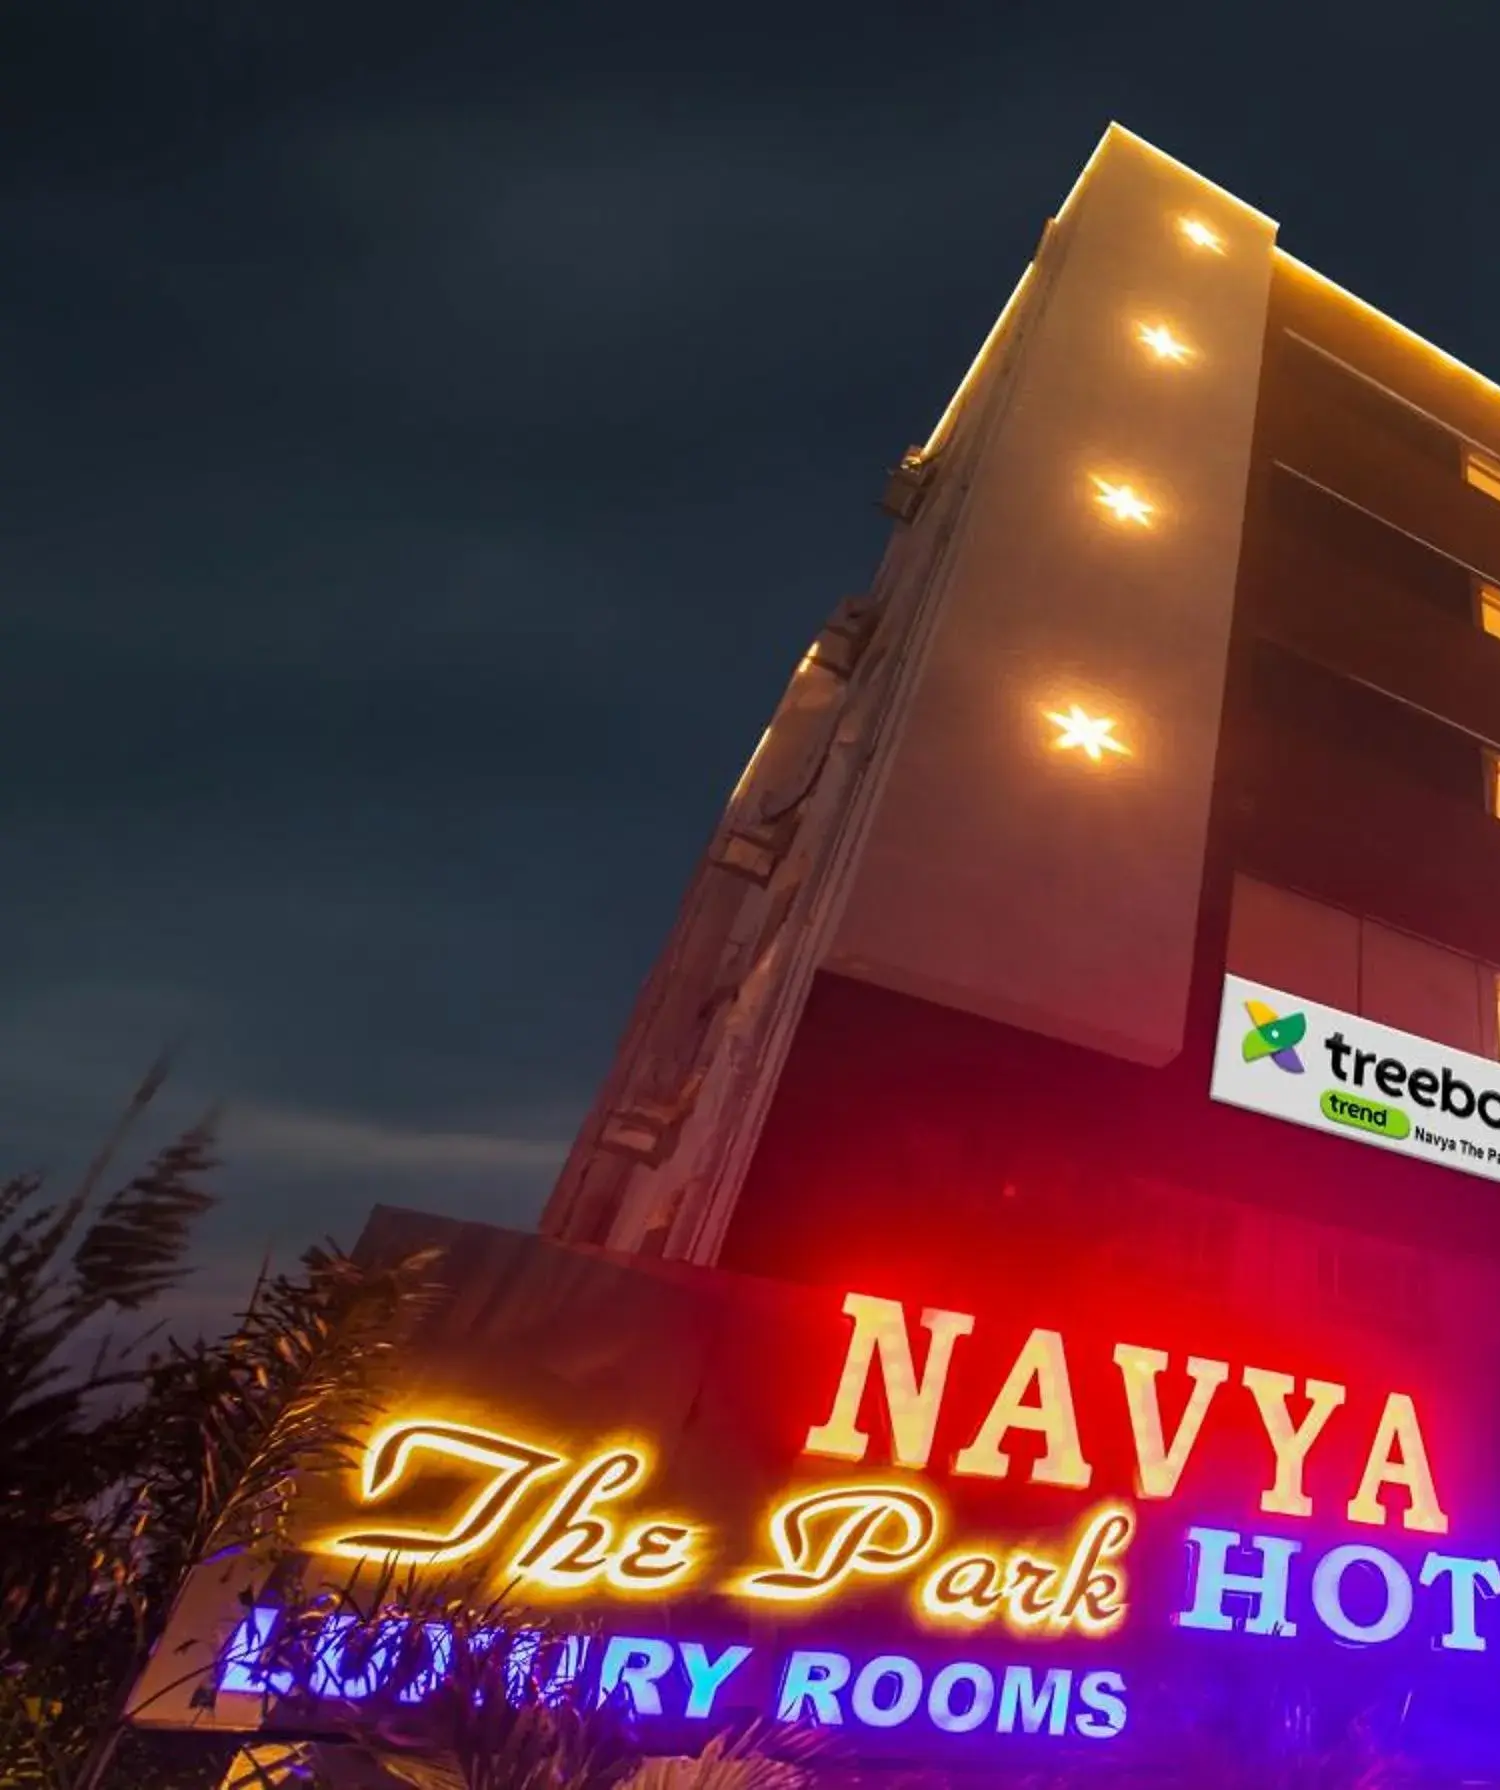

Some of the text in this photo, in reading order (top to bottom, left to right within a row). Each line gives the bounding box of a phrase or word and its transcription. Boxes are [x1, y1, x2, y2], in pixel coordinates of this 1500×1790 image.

[1329, 1094, 1388, 1127] trend
[1414, 1125, 1457, 1152] Navya
[1459, 1139, 1485, 1159] The
[803, 1292, 1448, 1533] NAVYA
[333, 1420, 1132, 1628] The Park
[776, 1650, 1128, 1739] ROOMS
